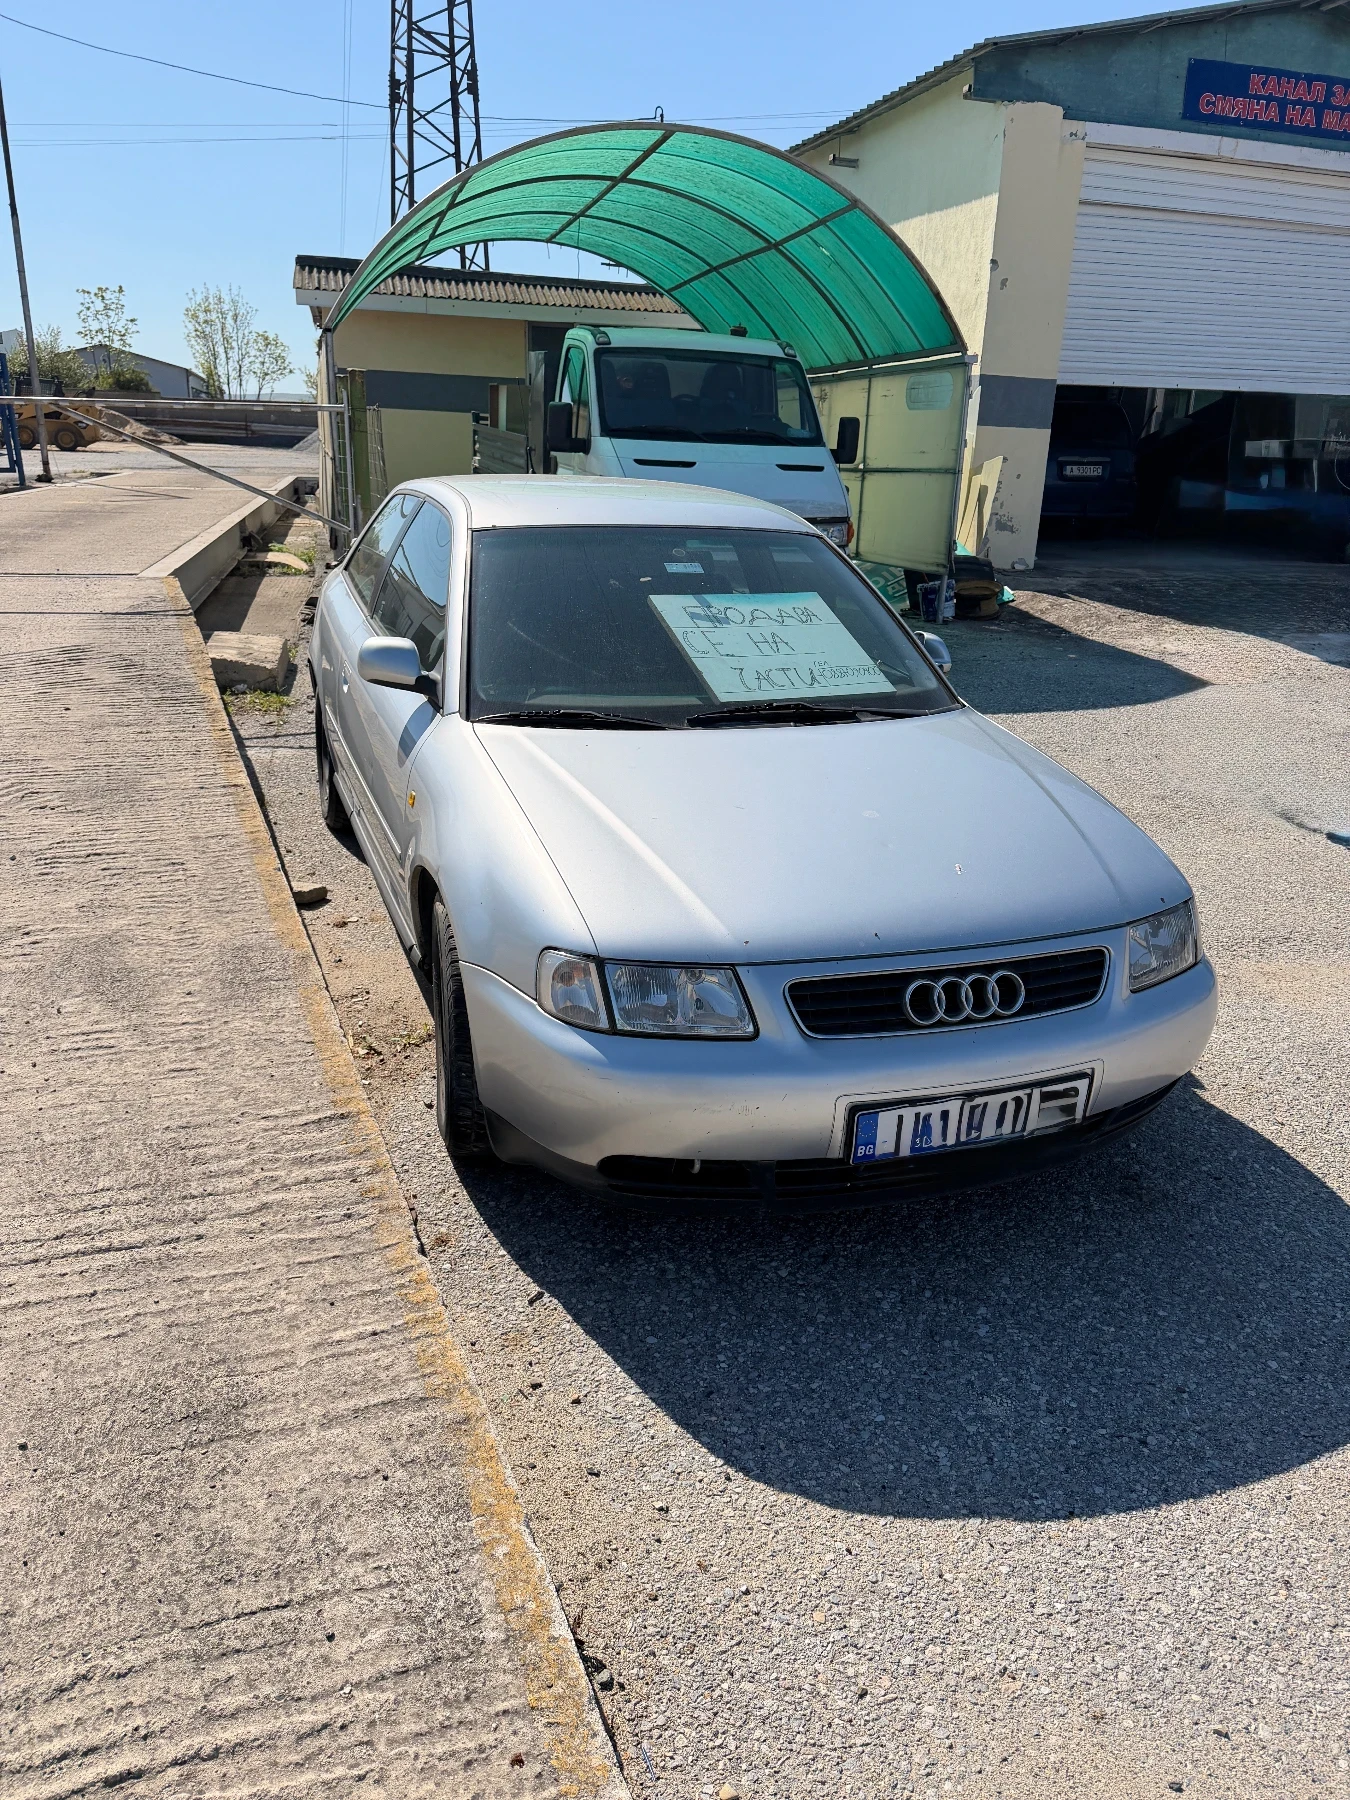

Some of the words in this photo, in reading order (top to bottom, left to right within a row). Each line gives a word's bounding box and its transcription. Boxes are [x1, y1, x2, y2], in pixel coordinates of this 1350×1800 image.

[1249, 74, 1326, 102] КАНАЛ
[1199, 93, 1279, 122] СМЯНА
[1285, 104, 1316, 127] НА
[682, 630, 735, 656] СЕ
[747, 631, 795, 654] НА
[857, 1145, 874, 1157] BG
